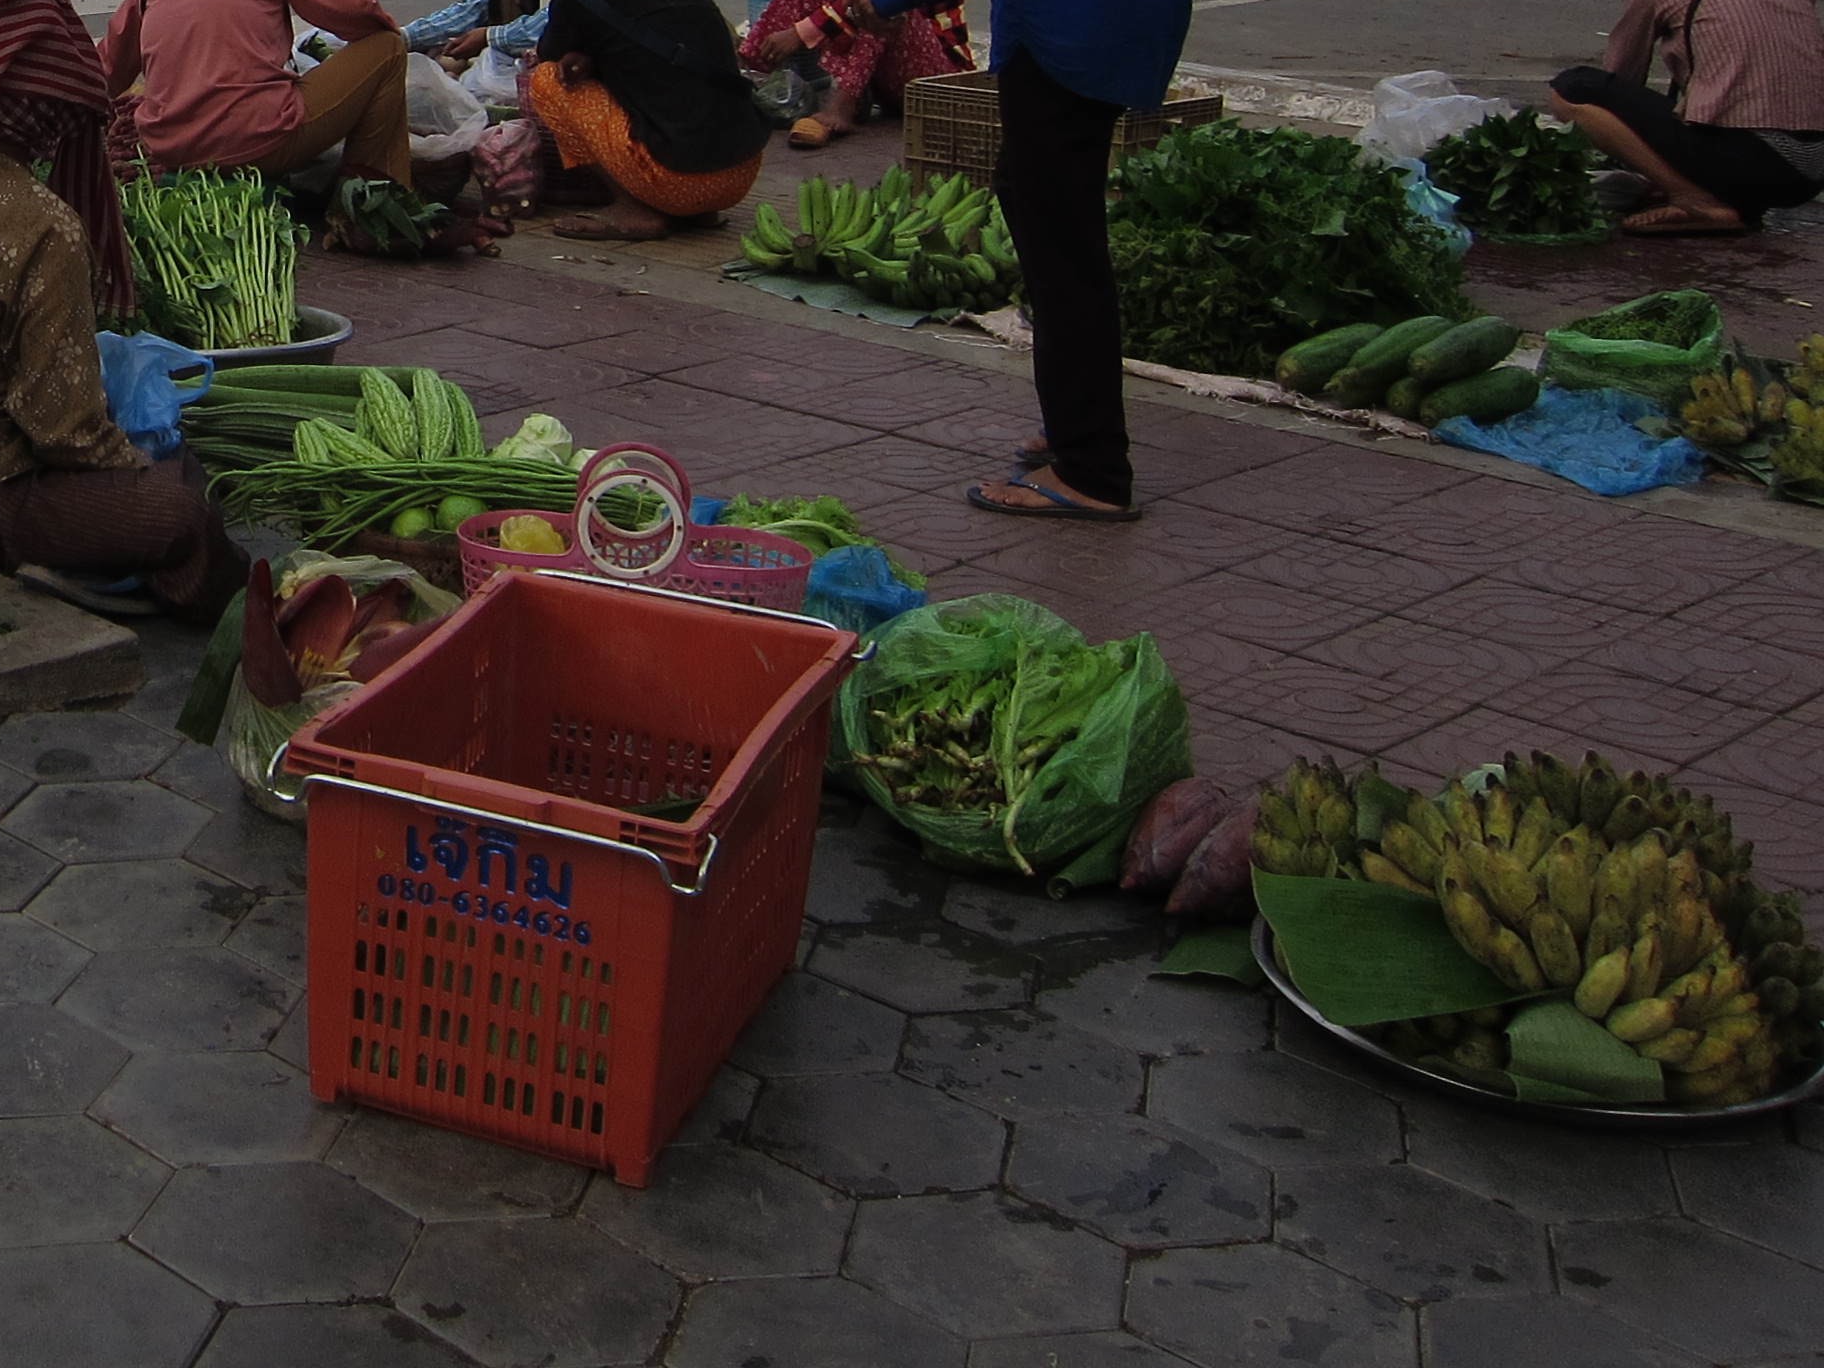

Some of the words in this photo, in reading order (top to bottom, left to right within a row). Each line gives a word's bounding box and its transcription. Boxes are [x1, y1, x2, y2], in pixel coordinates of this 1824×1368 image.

[406, 816, 573, 910] เจ๊กิม
[378, 873, 592, 945] 080-6364626
